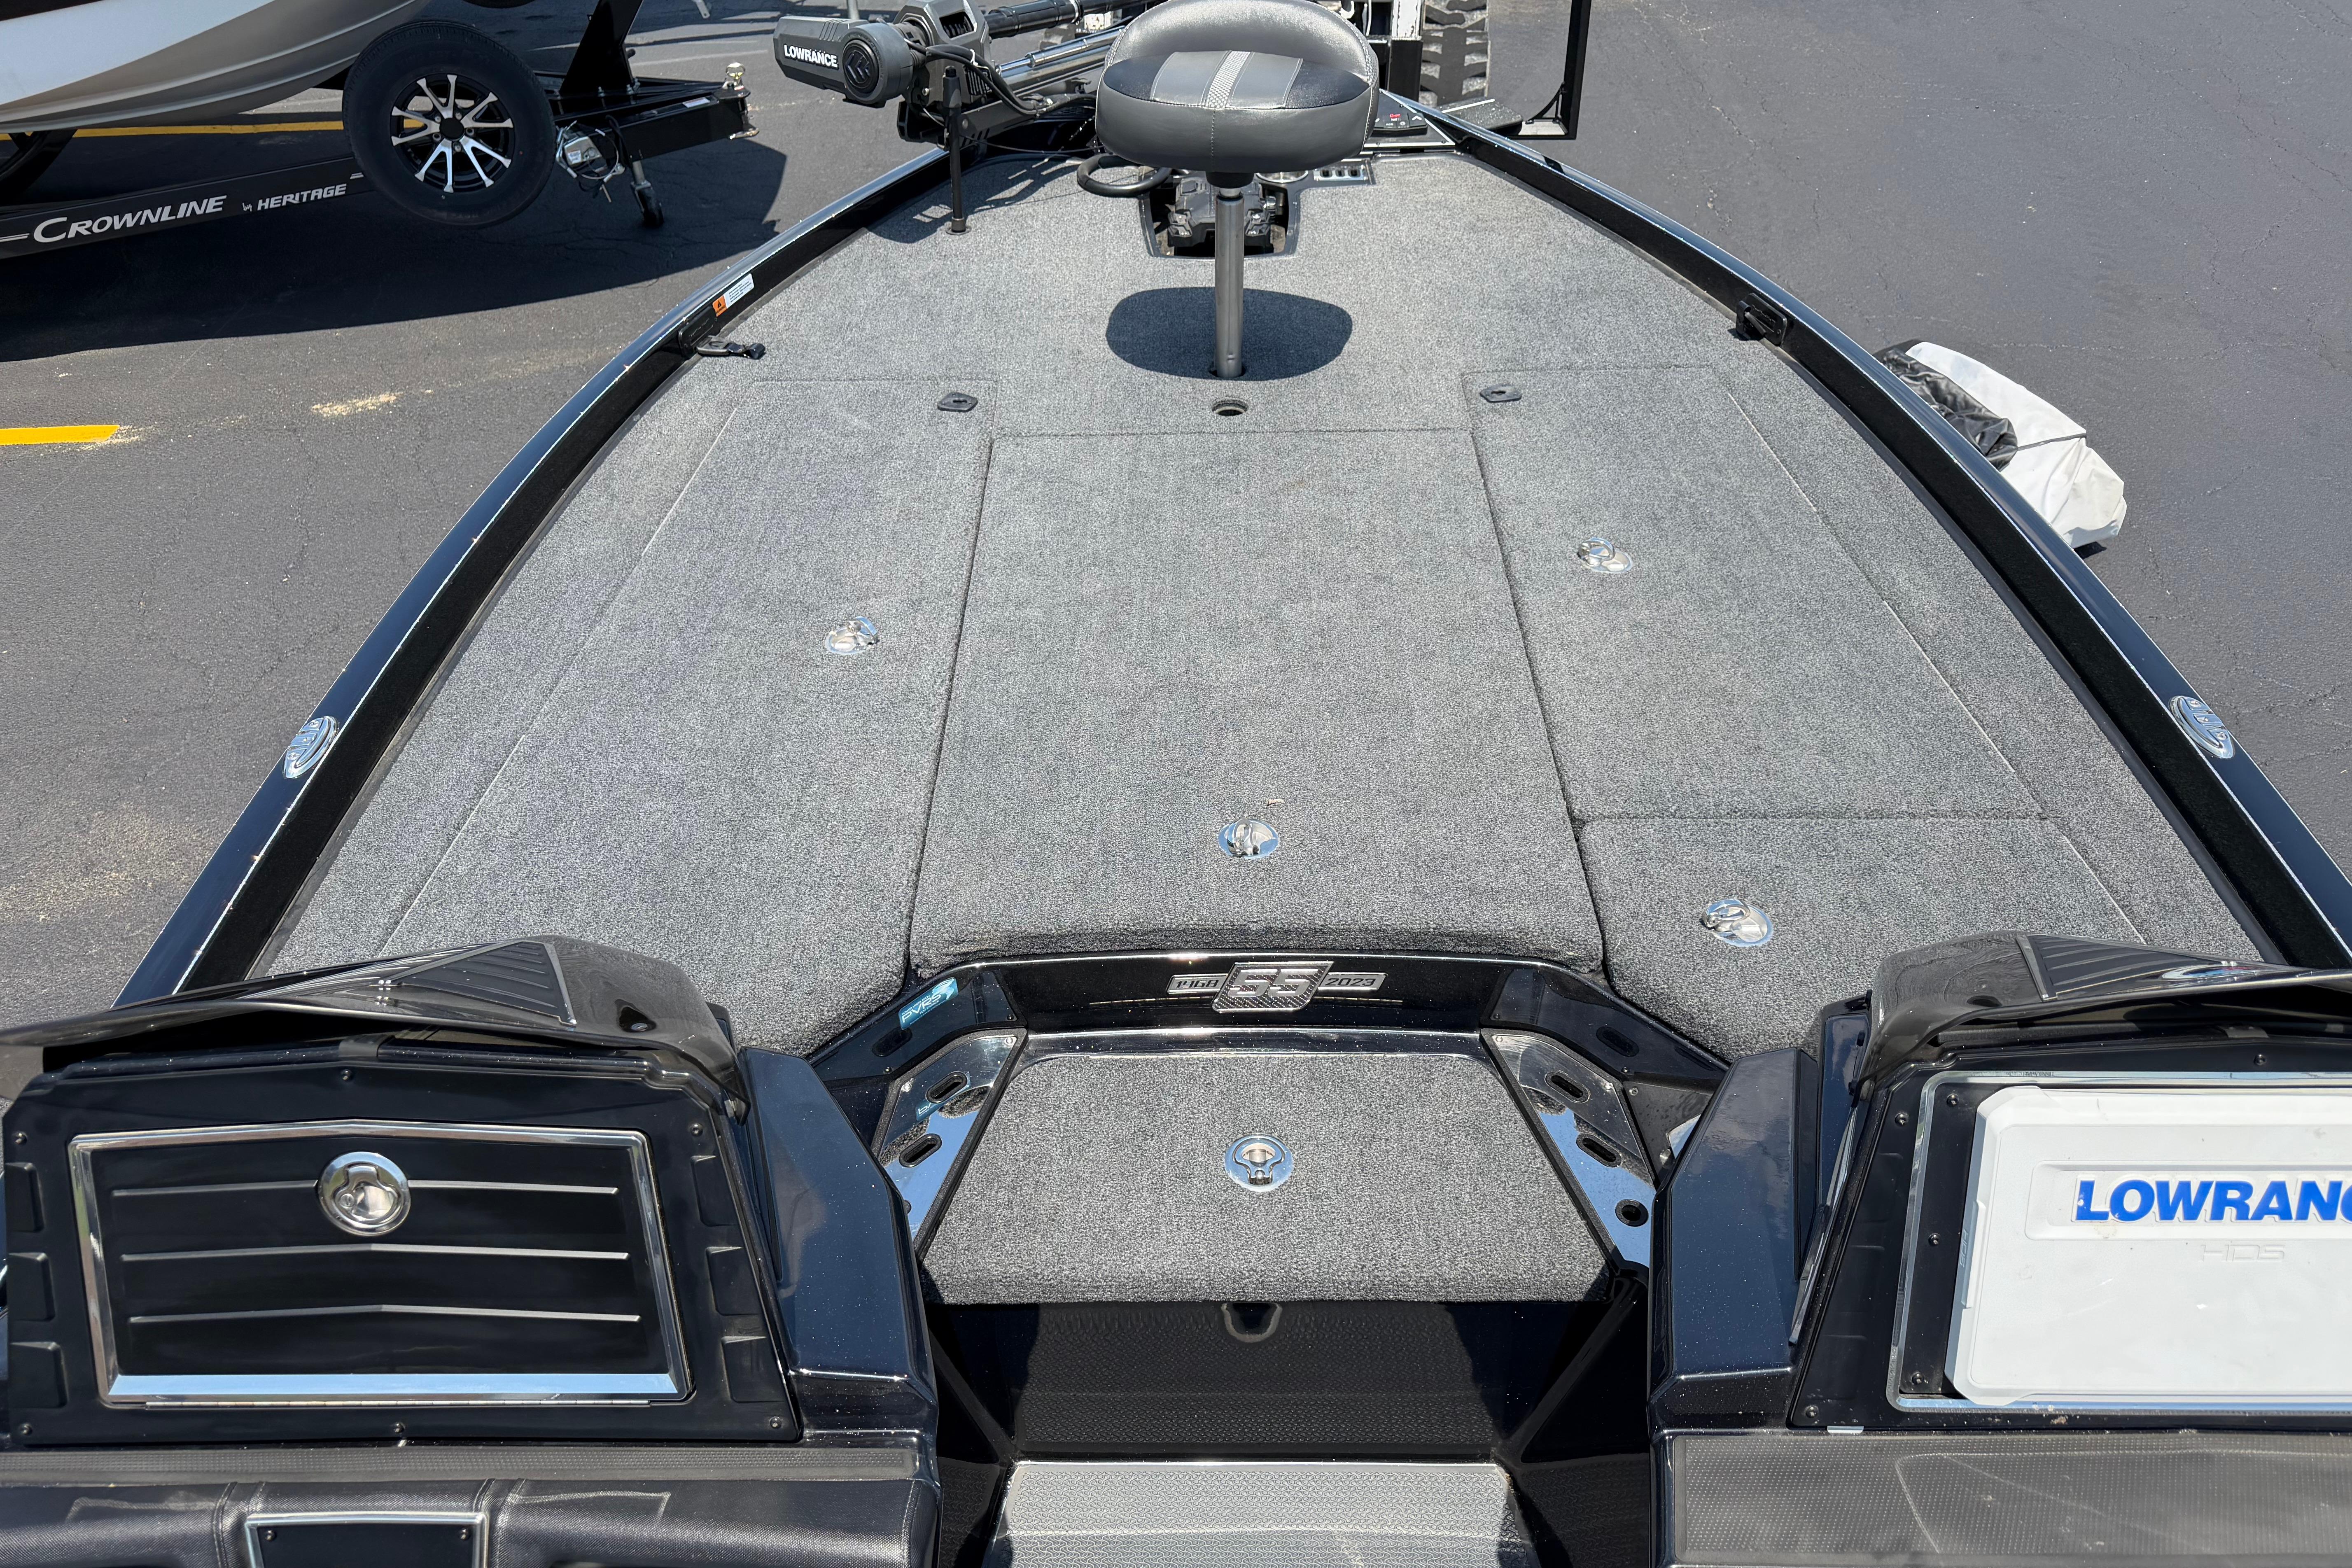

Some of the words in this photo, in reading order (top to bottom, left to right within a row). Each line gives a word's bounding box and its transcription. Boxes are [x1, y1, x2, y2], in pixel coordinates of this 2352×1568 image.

[784, 44, 838, 68] LOWRANCE
[34, 196, 226, 243] CROWNLINE
[242, 202, 253, 212] by
[257, 184, 347, 210] HERITAGE
[1176, 980, 1219, 988] 1968
[1228, 969, 1318, 997] 55
[1325, 978, 1376, 986] 2023
[902, 994, 941, 1023] PVRS
[2076, 1180, 2352, 1222] LOWRAN
